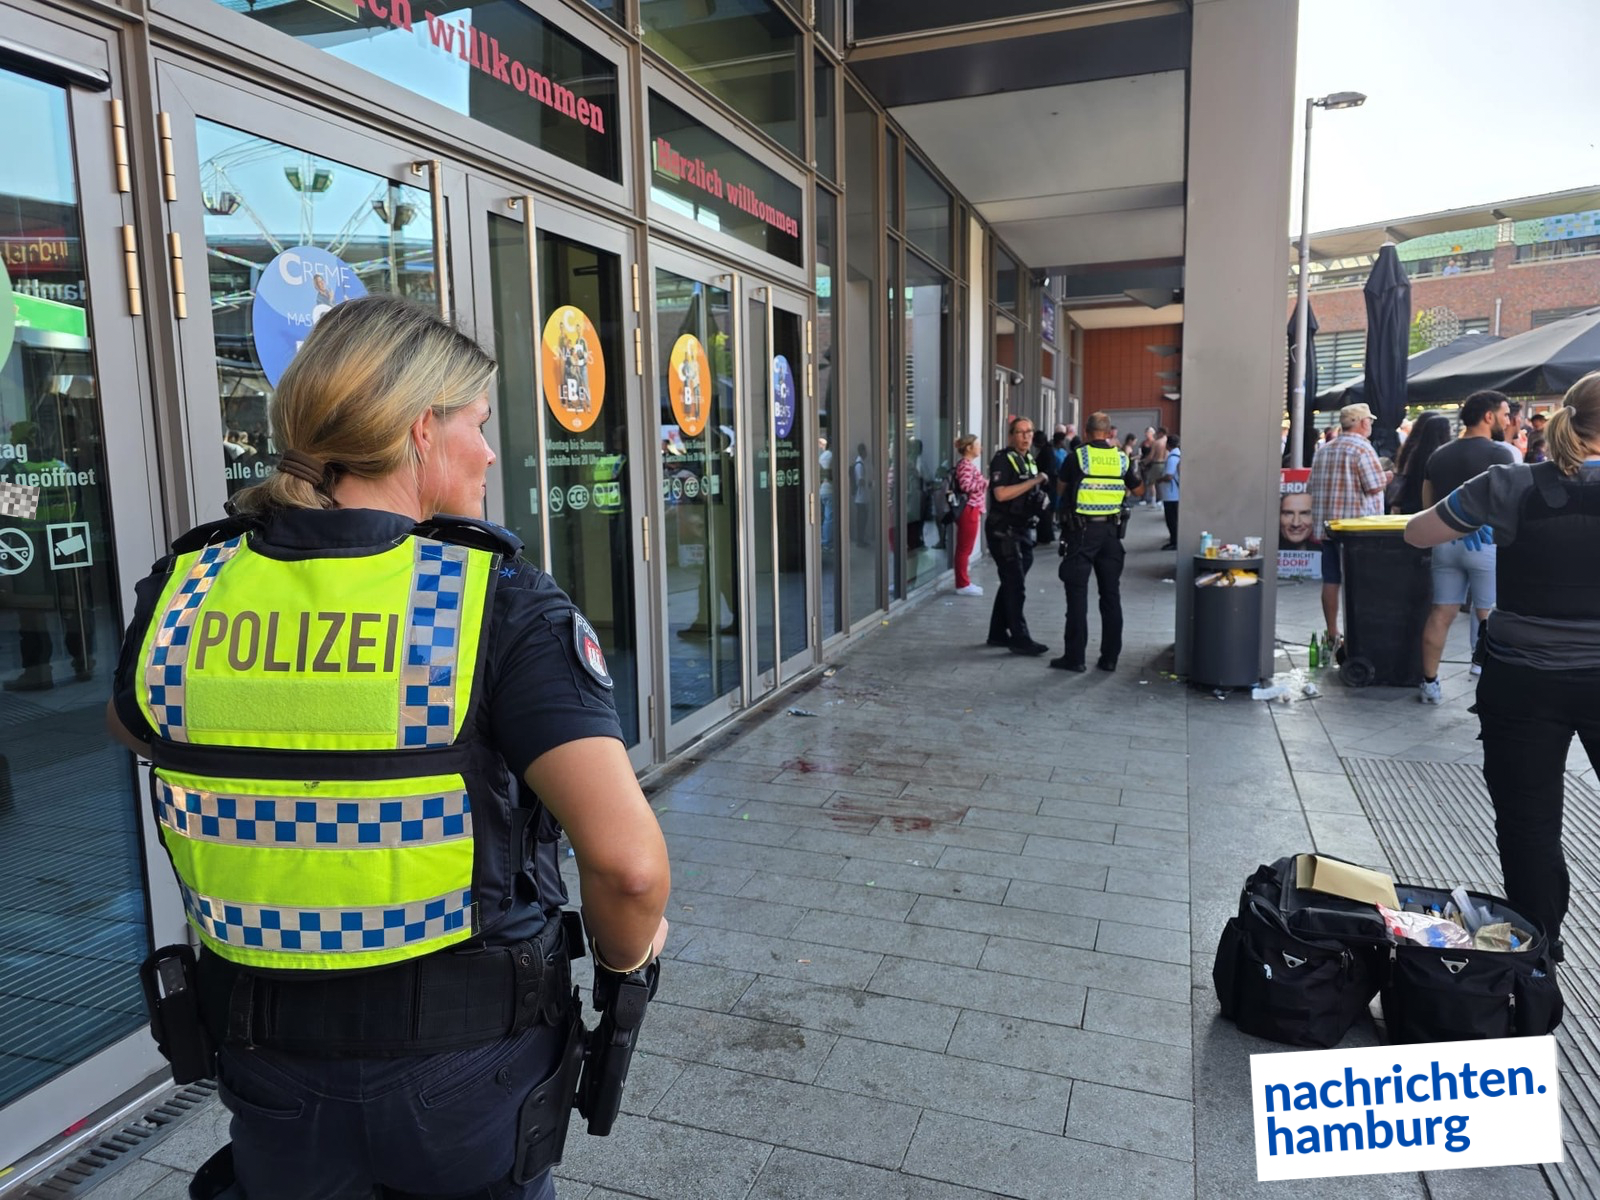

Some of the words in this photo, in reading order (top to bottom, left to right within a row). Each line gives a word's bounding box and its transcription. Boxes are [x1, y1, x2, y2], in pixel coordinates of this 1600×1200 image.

[425, 10, 604, 134] willkommen
[656, 137, 723, 199] Herzlich
[726, 182, 799, 238] willkommen
[15, 467, 96, 488] geöffnet
[224, 462, 251, 480] alle
[568, 490, 588, 504] CCB
[194, 610, 399, 673] POLIZEI
